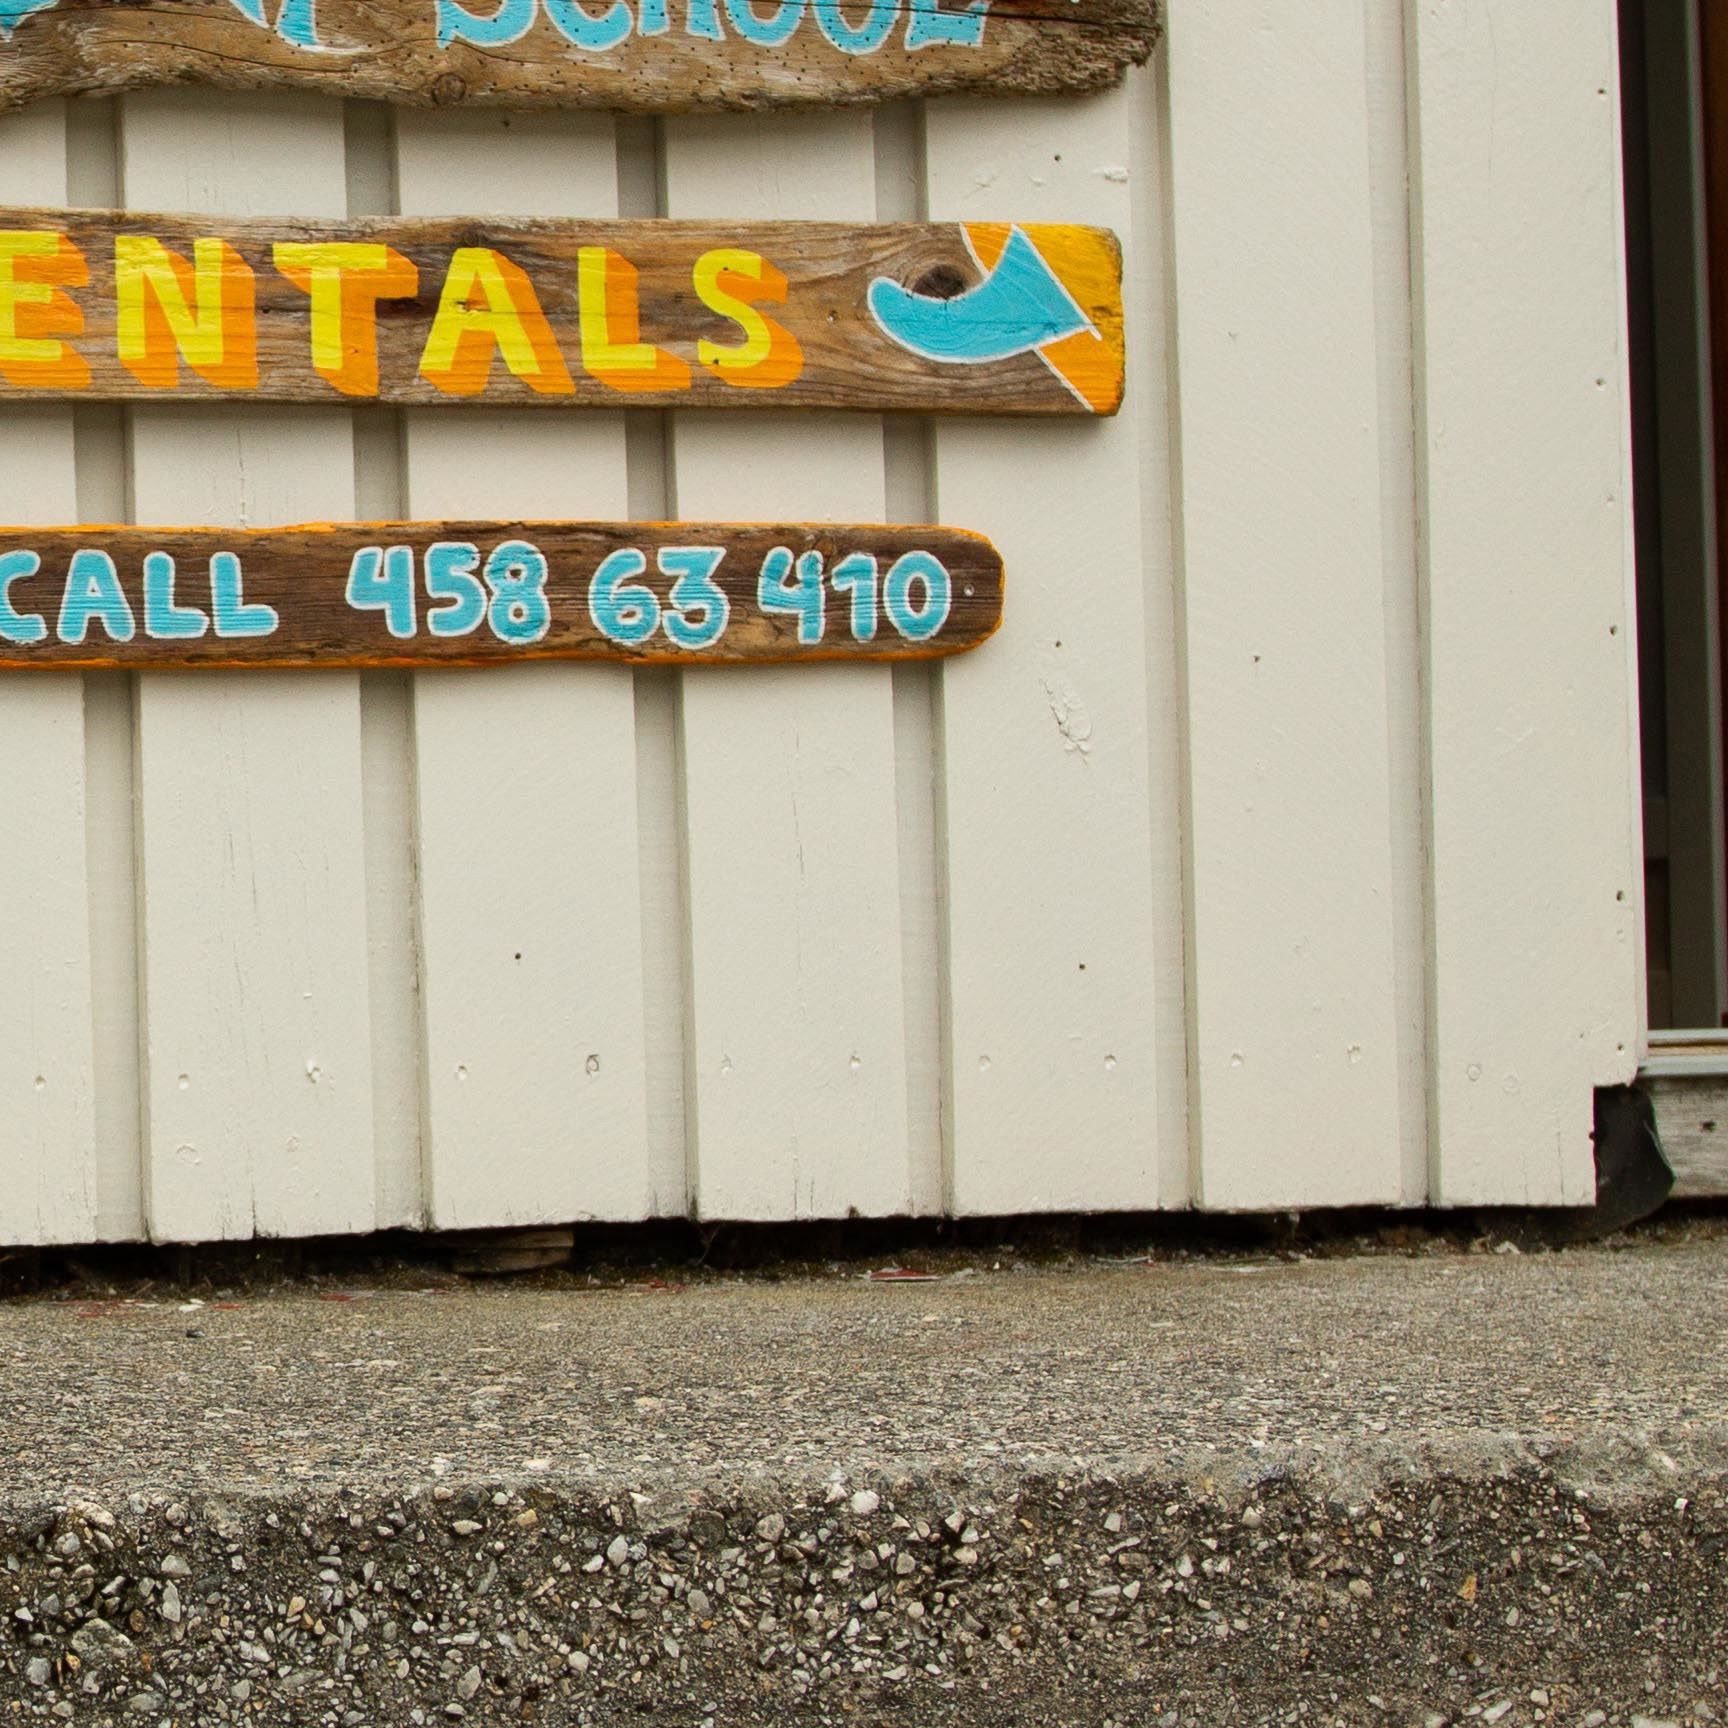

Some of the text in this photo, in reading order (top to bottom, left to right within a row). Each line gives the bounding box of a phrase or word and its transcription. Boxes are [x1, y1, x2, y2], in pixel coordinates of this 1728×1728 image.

[344, 539, 550, 647] 458
[587, 542, 728, 650] 63
[754, 542, 954, 646] 410
